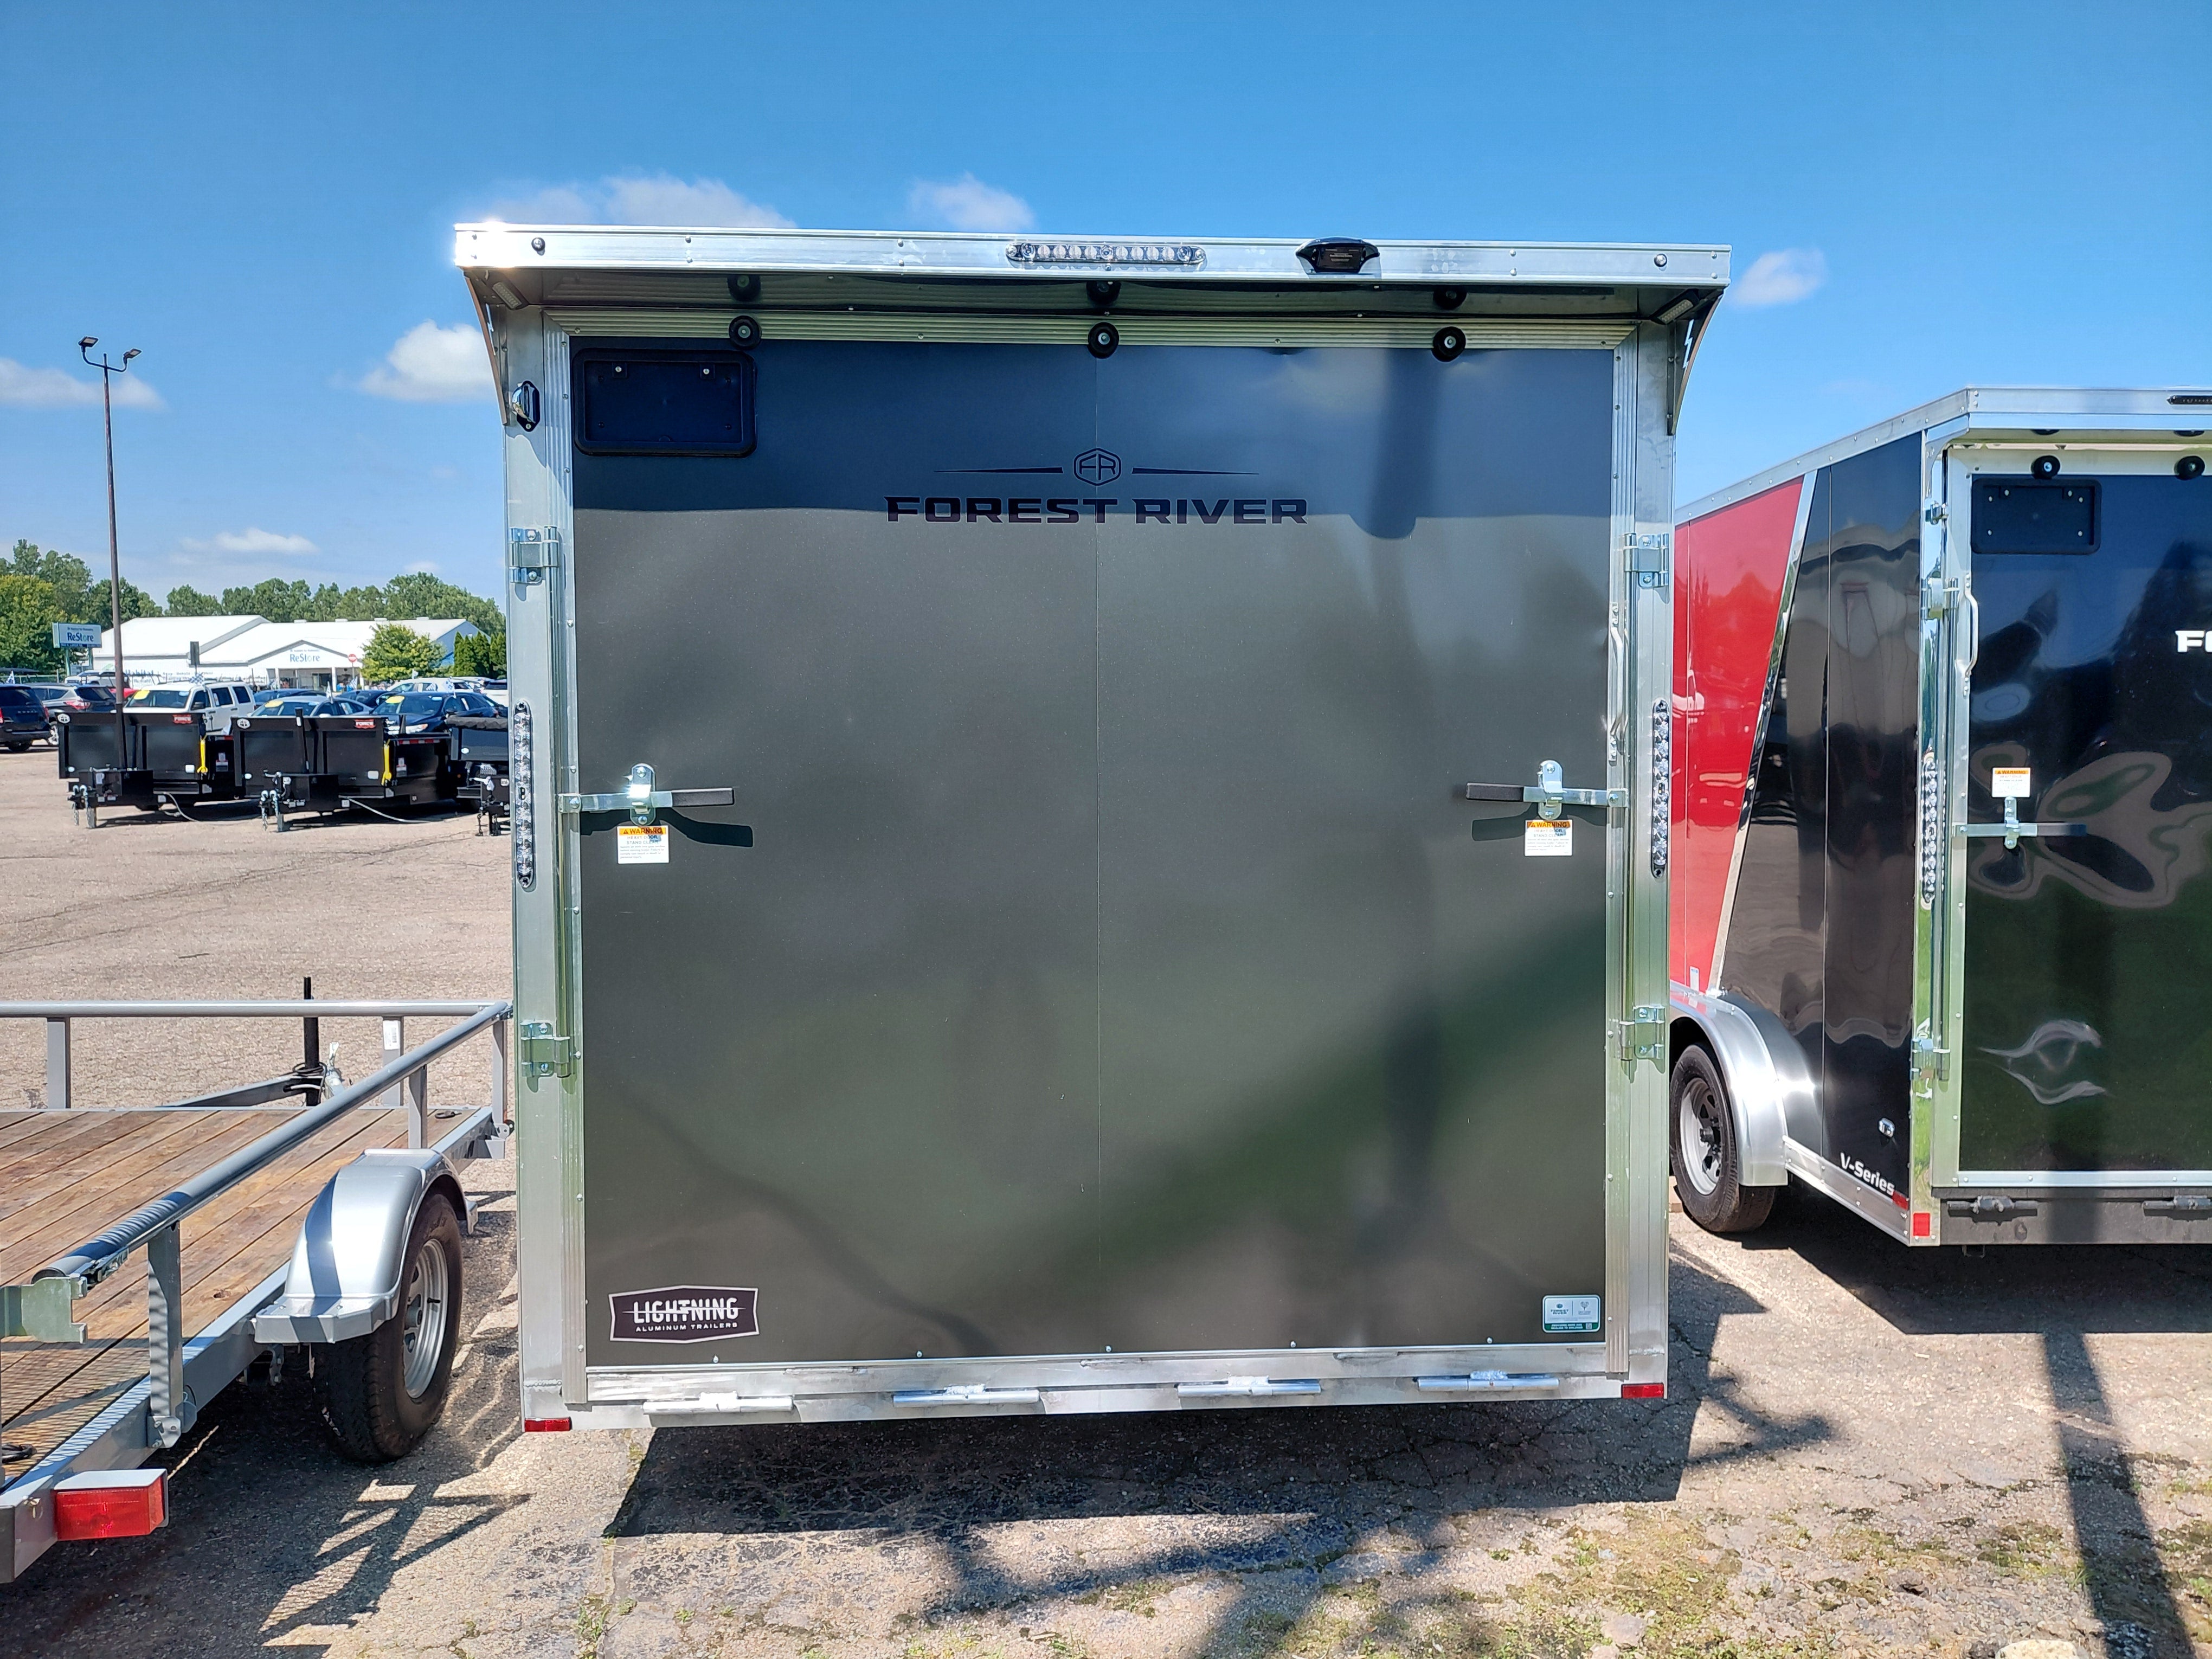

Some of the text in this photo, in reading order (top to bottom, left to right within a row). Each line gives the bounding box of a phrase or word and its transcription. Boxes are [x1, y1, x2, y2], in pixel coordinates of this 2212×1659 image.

[883, 496, 1309, 525] FOREST RIVER
[67, 632, 94, 641] ReStore
[290, 653, 320, 662] ReStore
[1841, 1152, 1895, 1196] V-Series
[633, 1297, 739, 1323] LIGHTNING
[635, 1324, 686, 1332] ALUMINUM
